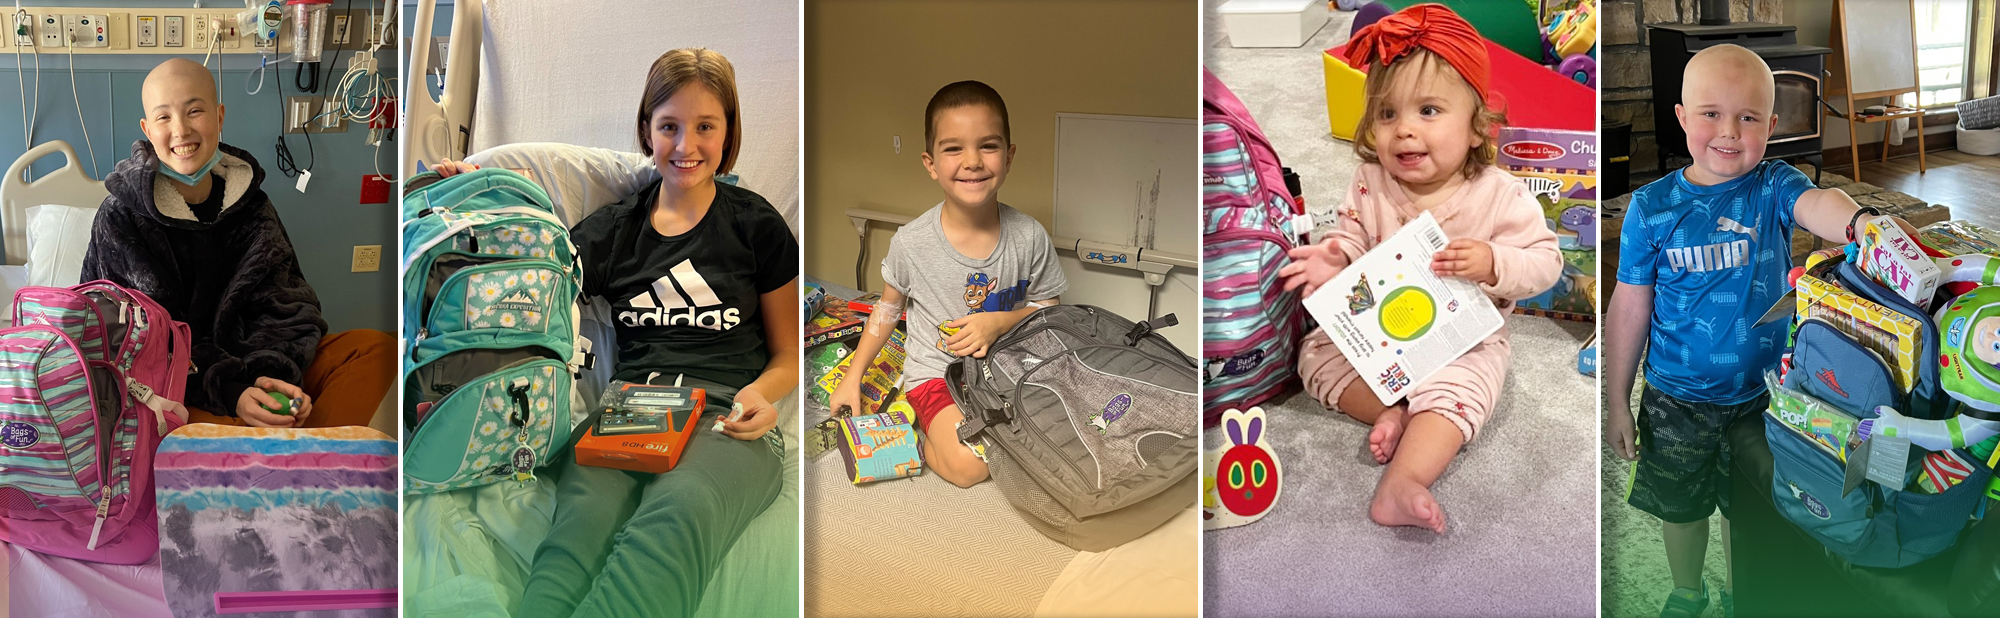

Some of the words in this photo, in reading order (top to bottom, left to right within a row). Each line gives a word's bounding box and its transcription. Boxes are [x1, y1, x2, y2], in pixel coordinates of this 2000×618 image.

[1507, 146, 1536, 154] Melissa
[1542, 147, 1562, 159] Doug
[1666, 239, 1749, 273] PUMA
[1891, 236, 1920, 261] CAT
[1873, 247, 1914, 292] CAT
[618, 306, 740, 331] adidas
[1380, 369, 1403, 393] ERIC
[1389, 362, 1410, 386] CARLE
[1780, 409, 1808, 429] POP!
[10, 427, 29, 436] Bags
[646, 444, 669, 453] fire
